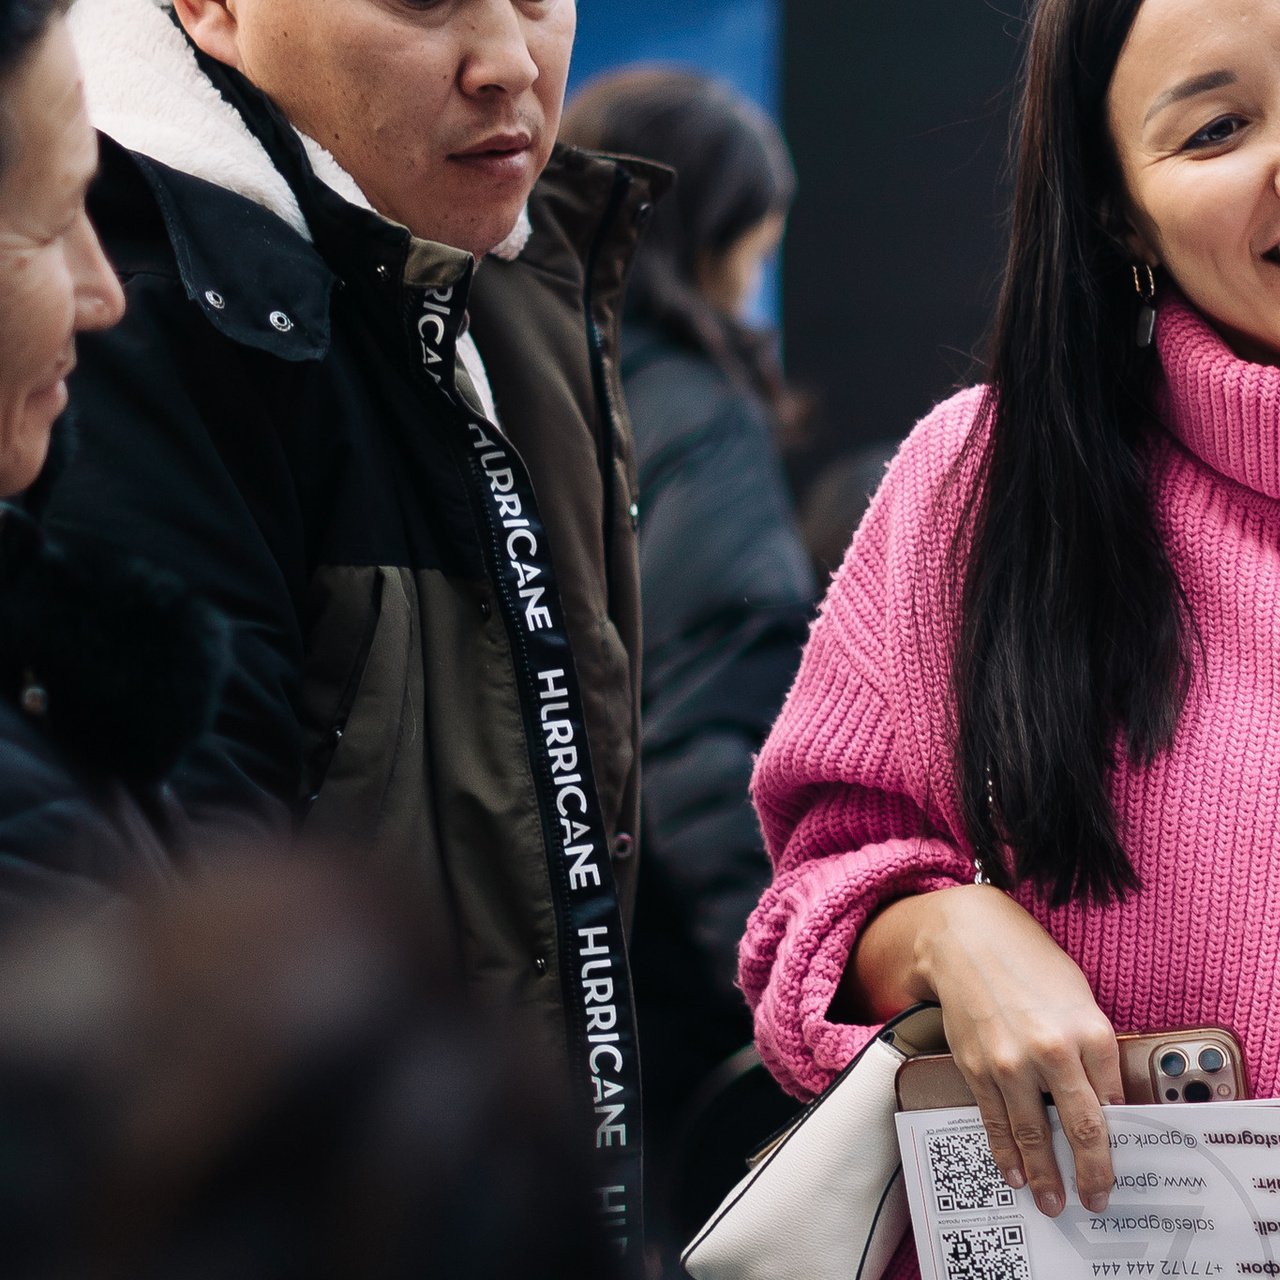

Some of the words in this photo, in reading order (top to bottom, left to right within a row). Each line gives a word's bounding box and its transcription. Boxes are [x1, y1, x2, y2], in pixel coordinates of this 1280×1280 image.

[537, 669, 601, 890] HURRICANE
[577, 926, 627, 1148] HURRICANE
[1111, 1172, 1207, 1190] www.gpark
[1089, 1215, 1215, 1233] sales@gpark.kz
[1092, 1262, 1121, 1277] 444
[1126, 1260, 1155, 1276] 444
[1160, 1260, 1199, 1276] 7172
[1205, 1260, 1223, 1275] +7
